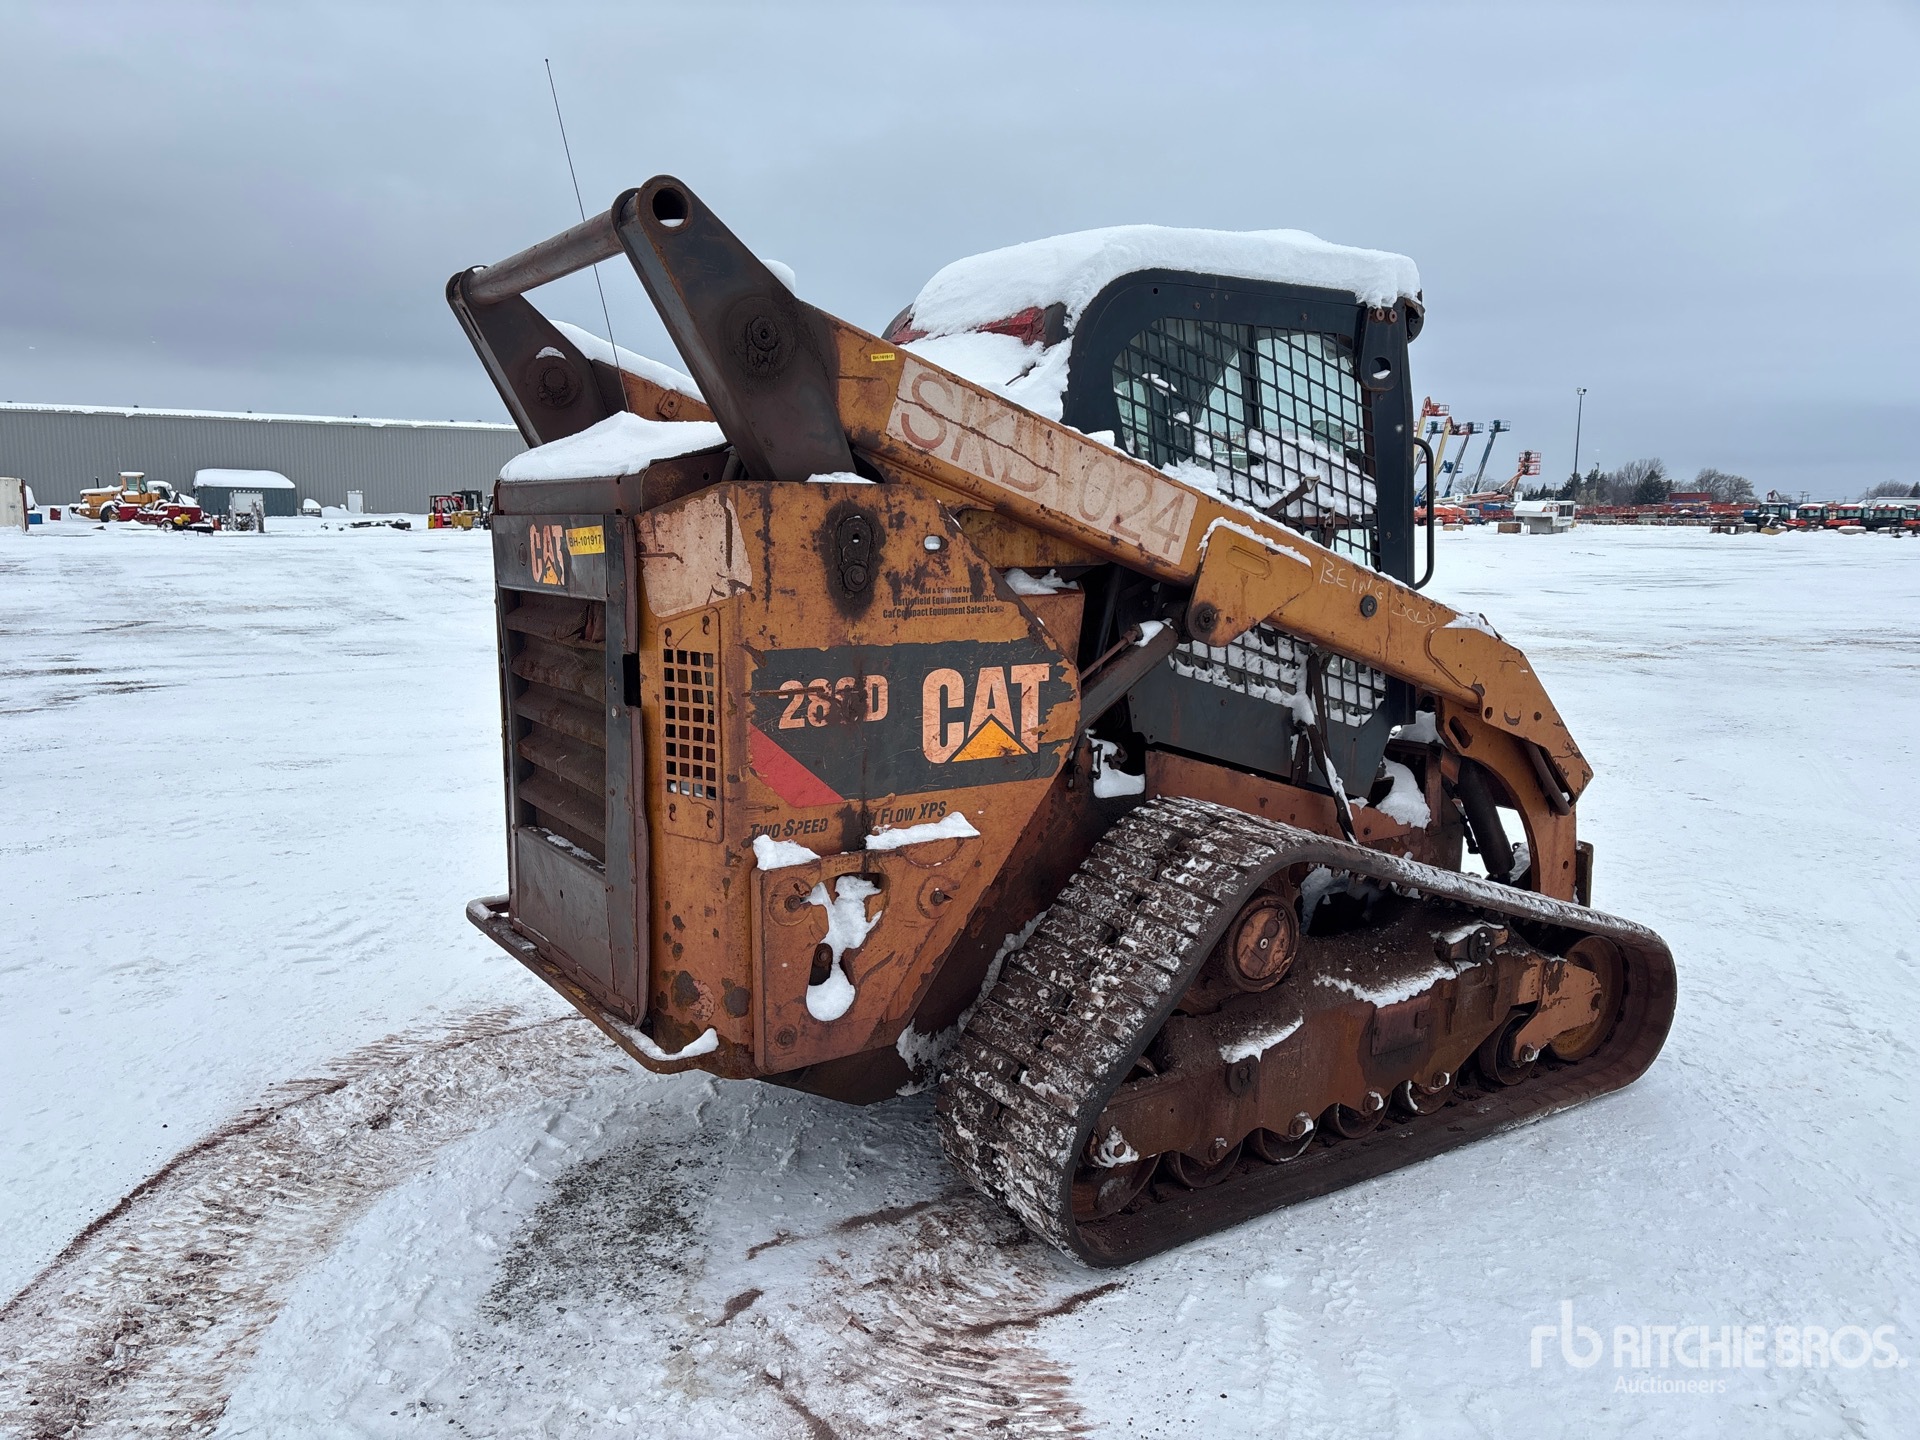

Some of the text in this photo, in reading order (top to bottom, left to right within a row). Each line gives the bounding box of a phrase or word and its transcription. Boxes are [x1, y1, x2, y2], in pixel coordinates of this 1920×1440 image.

[900, 371, 1188, 555] SKD 024
[569, 535, 602, 547] BH-101917
[529, 524, 565, 586] CAT
[883, 608, 896, 618] Cat
[896, 608, 928, 617] Copact
[929, 605, 966, 615] Equipment
[966, 604, 986, 614] Sales
[932, 595, 968, 604] Equipment
[922, 663, 1050, 764] CAT
[880, 808, 916, 824] FLOW
[918, 801, 947, 819] XPS
